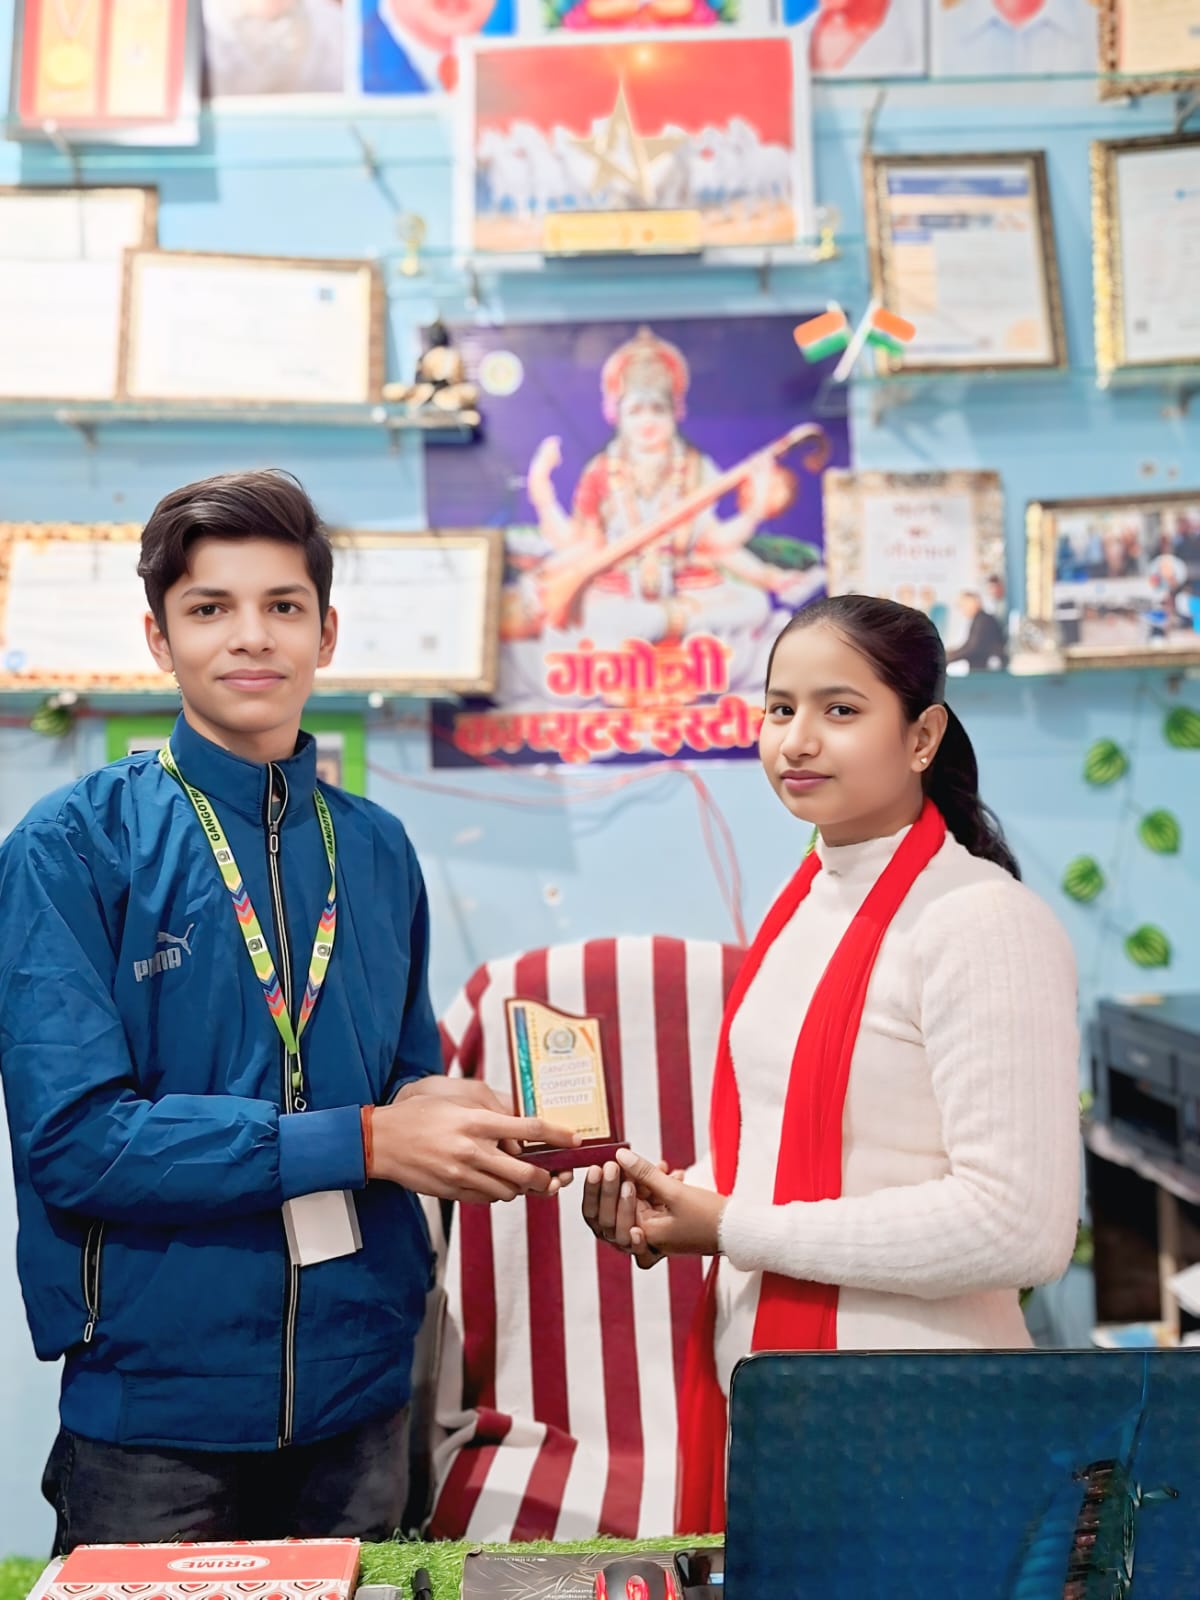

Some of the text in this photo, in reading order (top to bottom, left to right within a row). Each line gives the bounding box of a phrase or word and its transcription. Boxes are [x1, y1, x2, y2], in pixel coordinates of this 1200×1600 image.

[545, 635, 731, 695] गंगोत्री
[189, 788, 220, 841] GANGOTRI
[181, 1560, 256, 1569] PRIME
